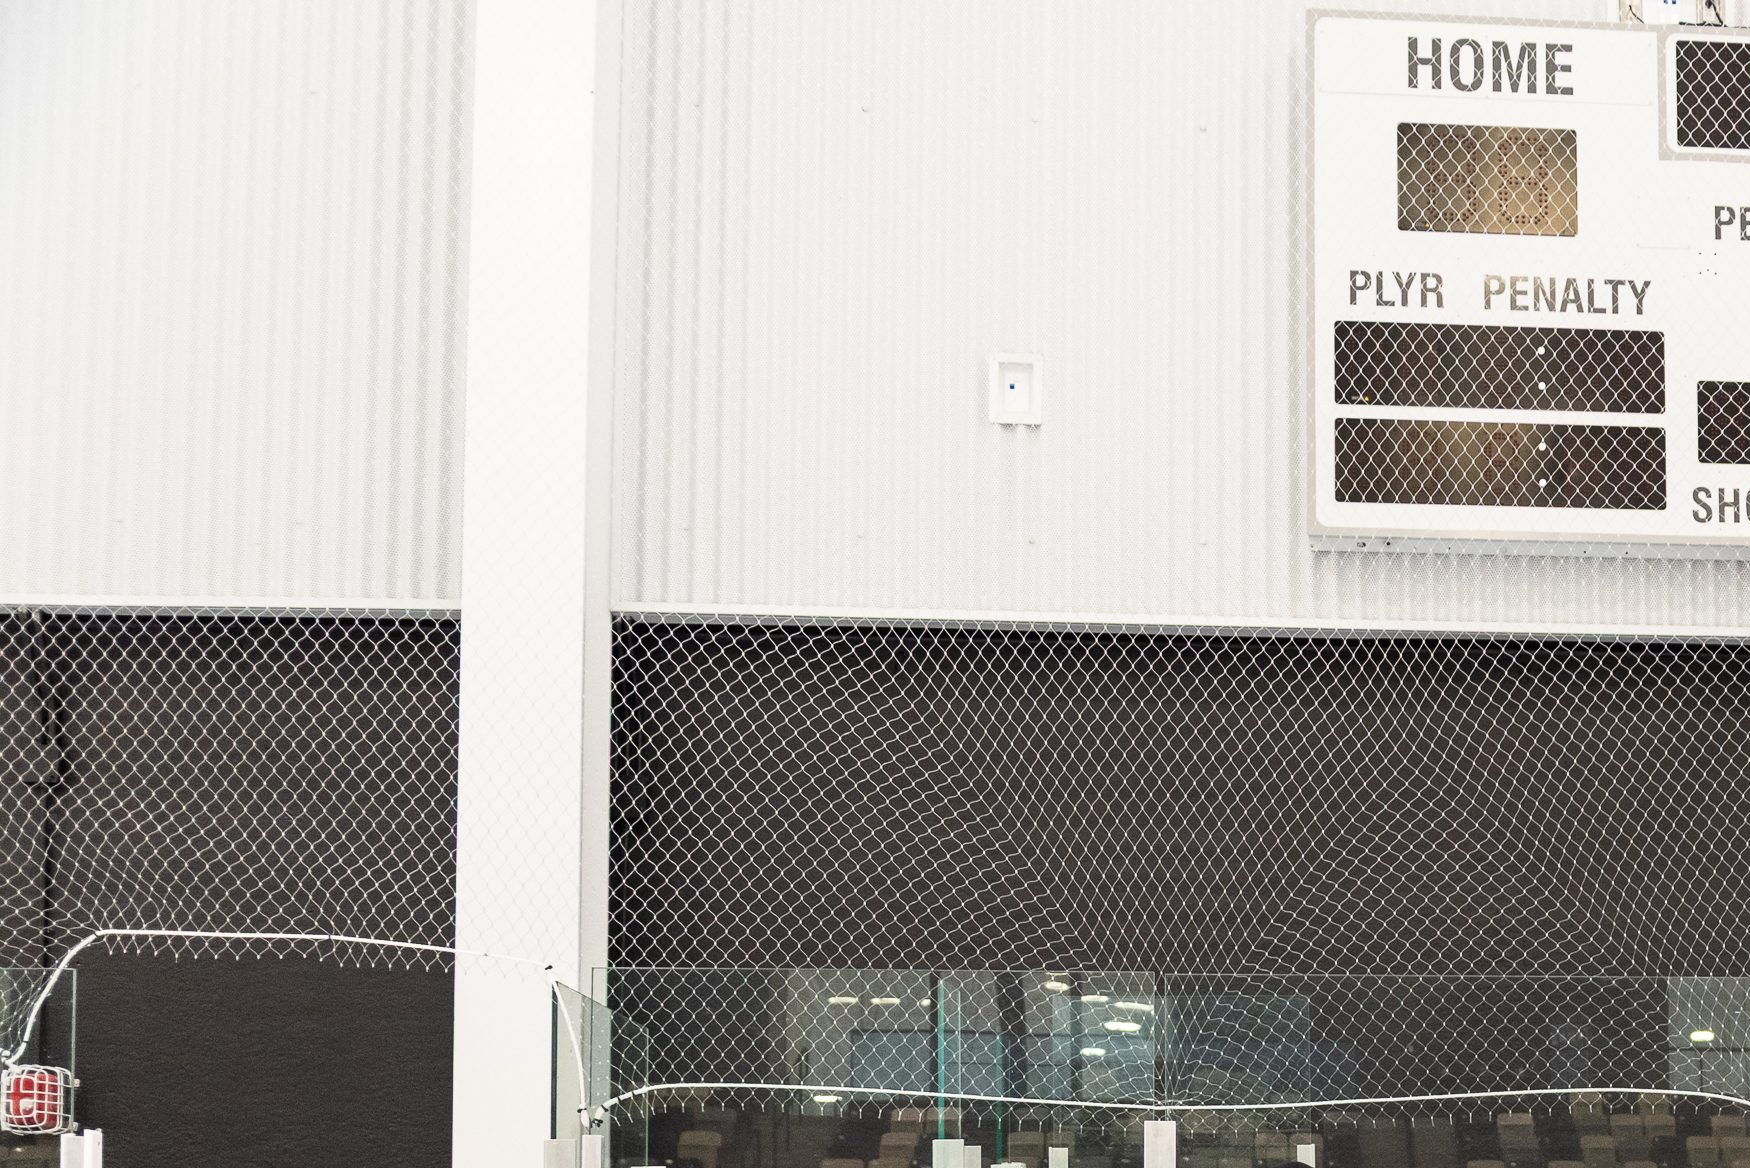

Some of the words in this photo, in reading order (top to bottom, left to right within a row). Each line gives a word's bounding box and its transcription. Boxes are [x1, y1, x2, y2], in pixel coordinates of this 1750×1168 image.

[1408, 36, 1574, 96] HOME
[1349, 270, 1445, 310] PLYR
[1483, 275, 1652, 316] PENALTY
